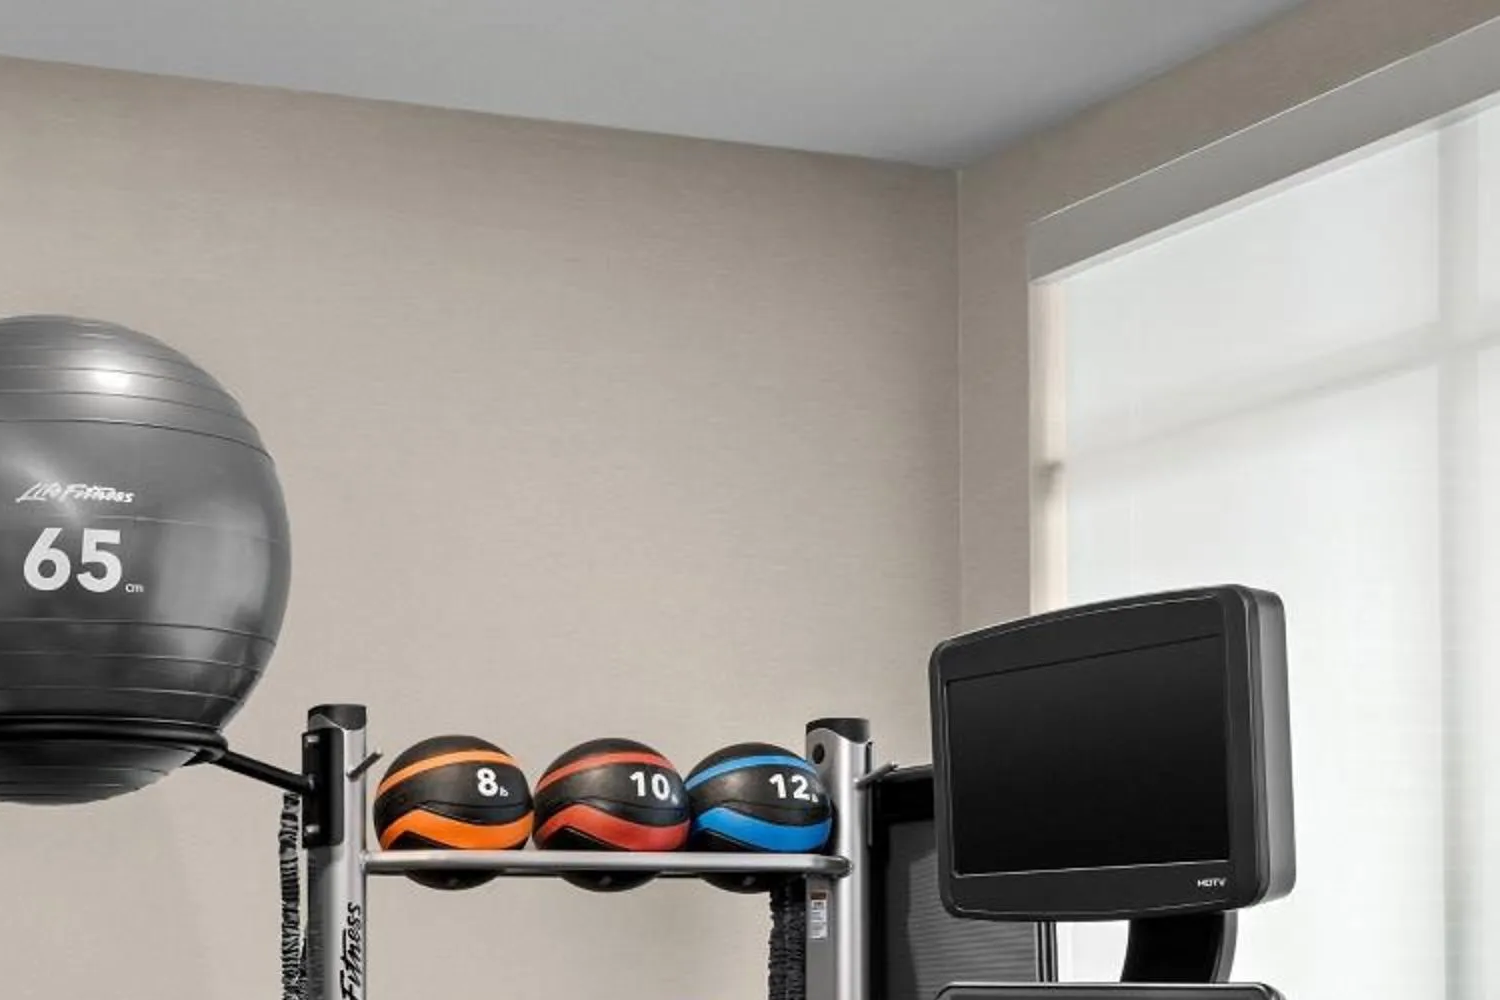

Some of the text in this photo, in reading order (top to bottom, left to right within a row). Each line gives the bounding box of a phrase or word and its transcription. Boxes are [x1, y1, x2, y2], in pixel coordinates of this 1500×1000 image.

[23, 527, 122, 593] 65
[477, 767, 499, 797] 8
[629, 771, 670, 800] 10
[769, 773, 810, 801] 12
[1197, 877, 1227, 887] HDTV
